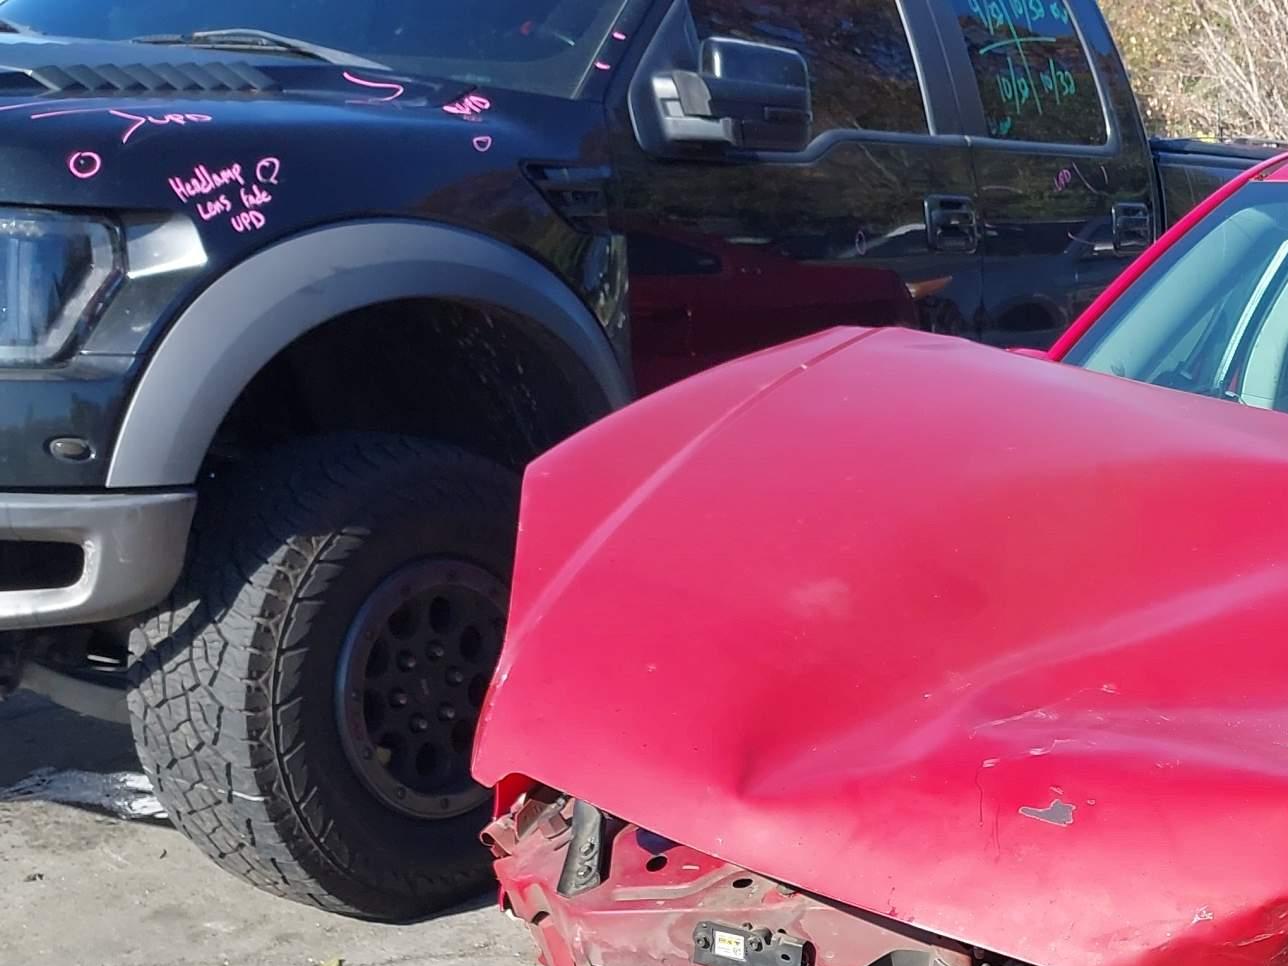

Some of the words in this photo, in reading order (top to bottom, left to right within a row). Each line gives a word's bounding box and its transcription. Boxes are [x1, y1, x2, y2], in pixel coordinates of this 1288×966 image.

[168, 163, 244, 203] Headlamp
[196, 194, 231, 220] Lens
[231, 210, 266, 232] UPD
